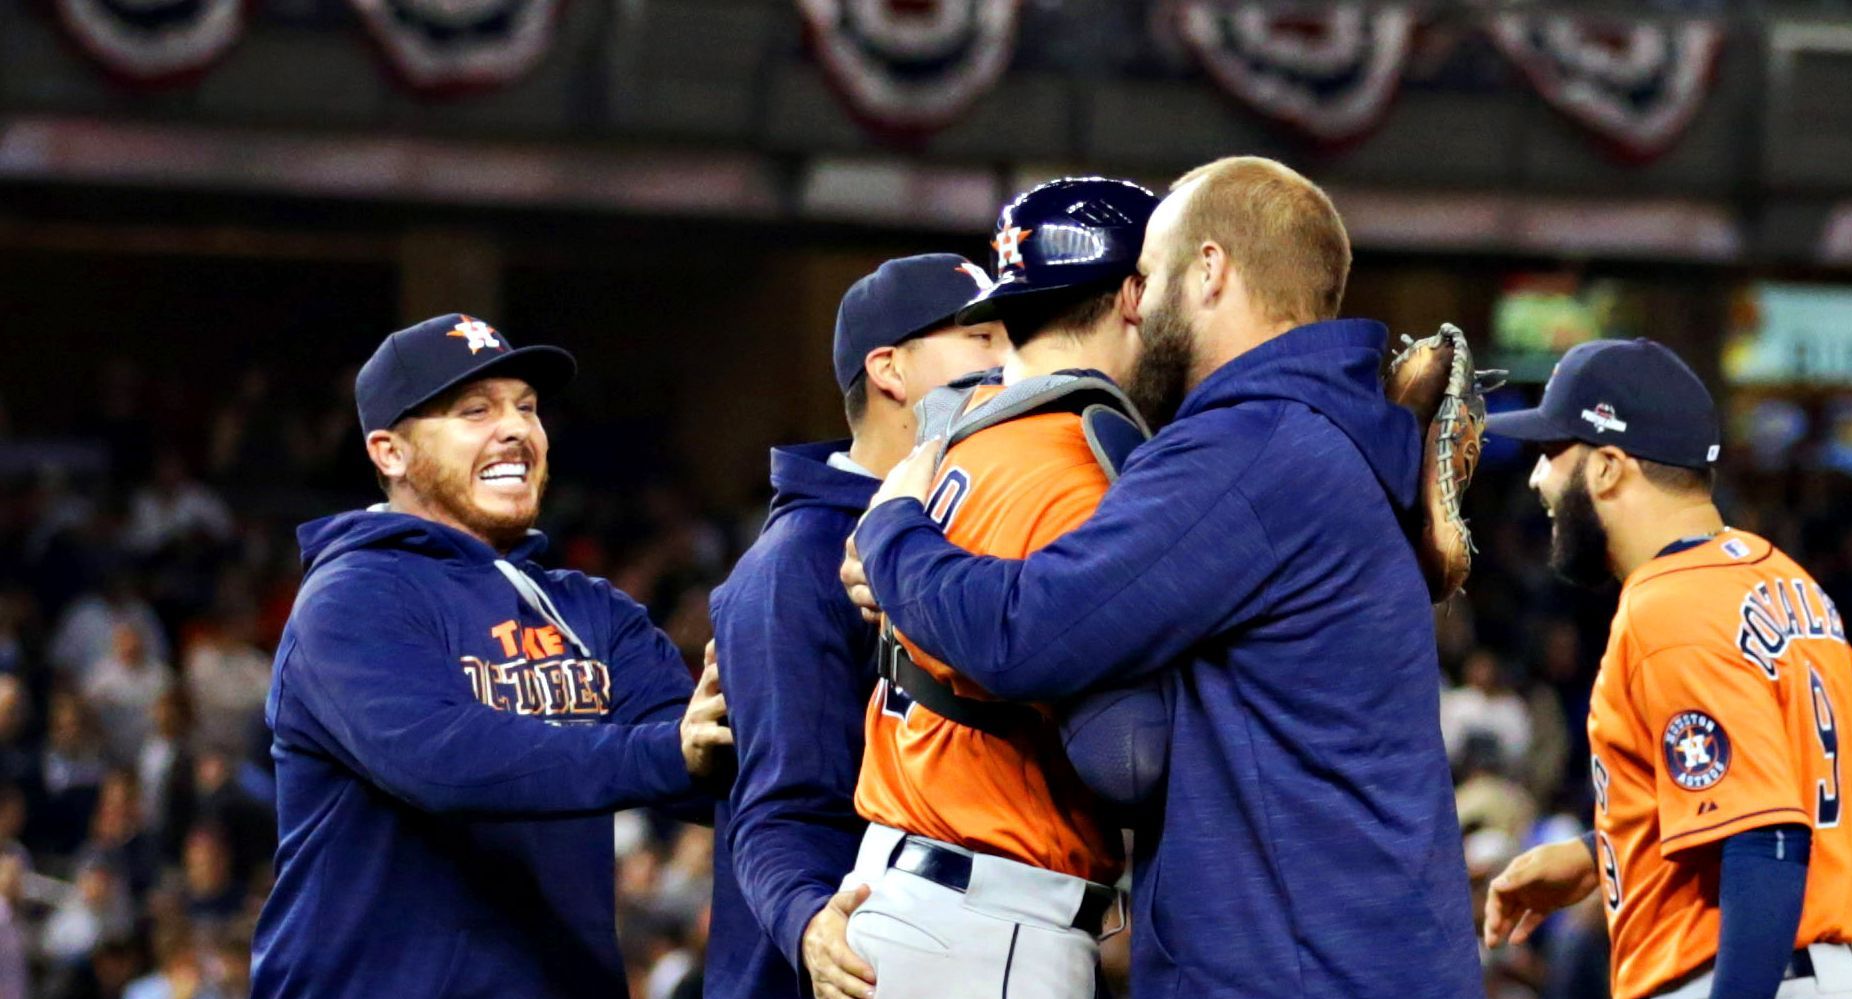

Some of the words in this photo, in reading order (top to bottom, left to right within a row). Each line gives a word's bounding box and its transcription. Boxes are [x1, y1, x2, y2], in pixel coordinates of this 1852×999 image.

[996, 226, 1024, 270] H
[491, 620, 565, 660] TKE
[1666, 713, 1715, 744] HOUSTON
[1804, 660, 1841, 830] 9
[1680, 734, 1711, 768] H
[1677, 761, 1725, 788] ASTROS
